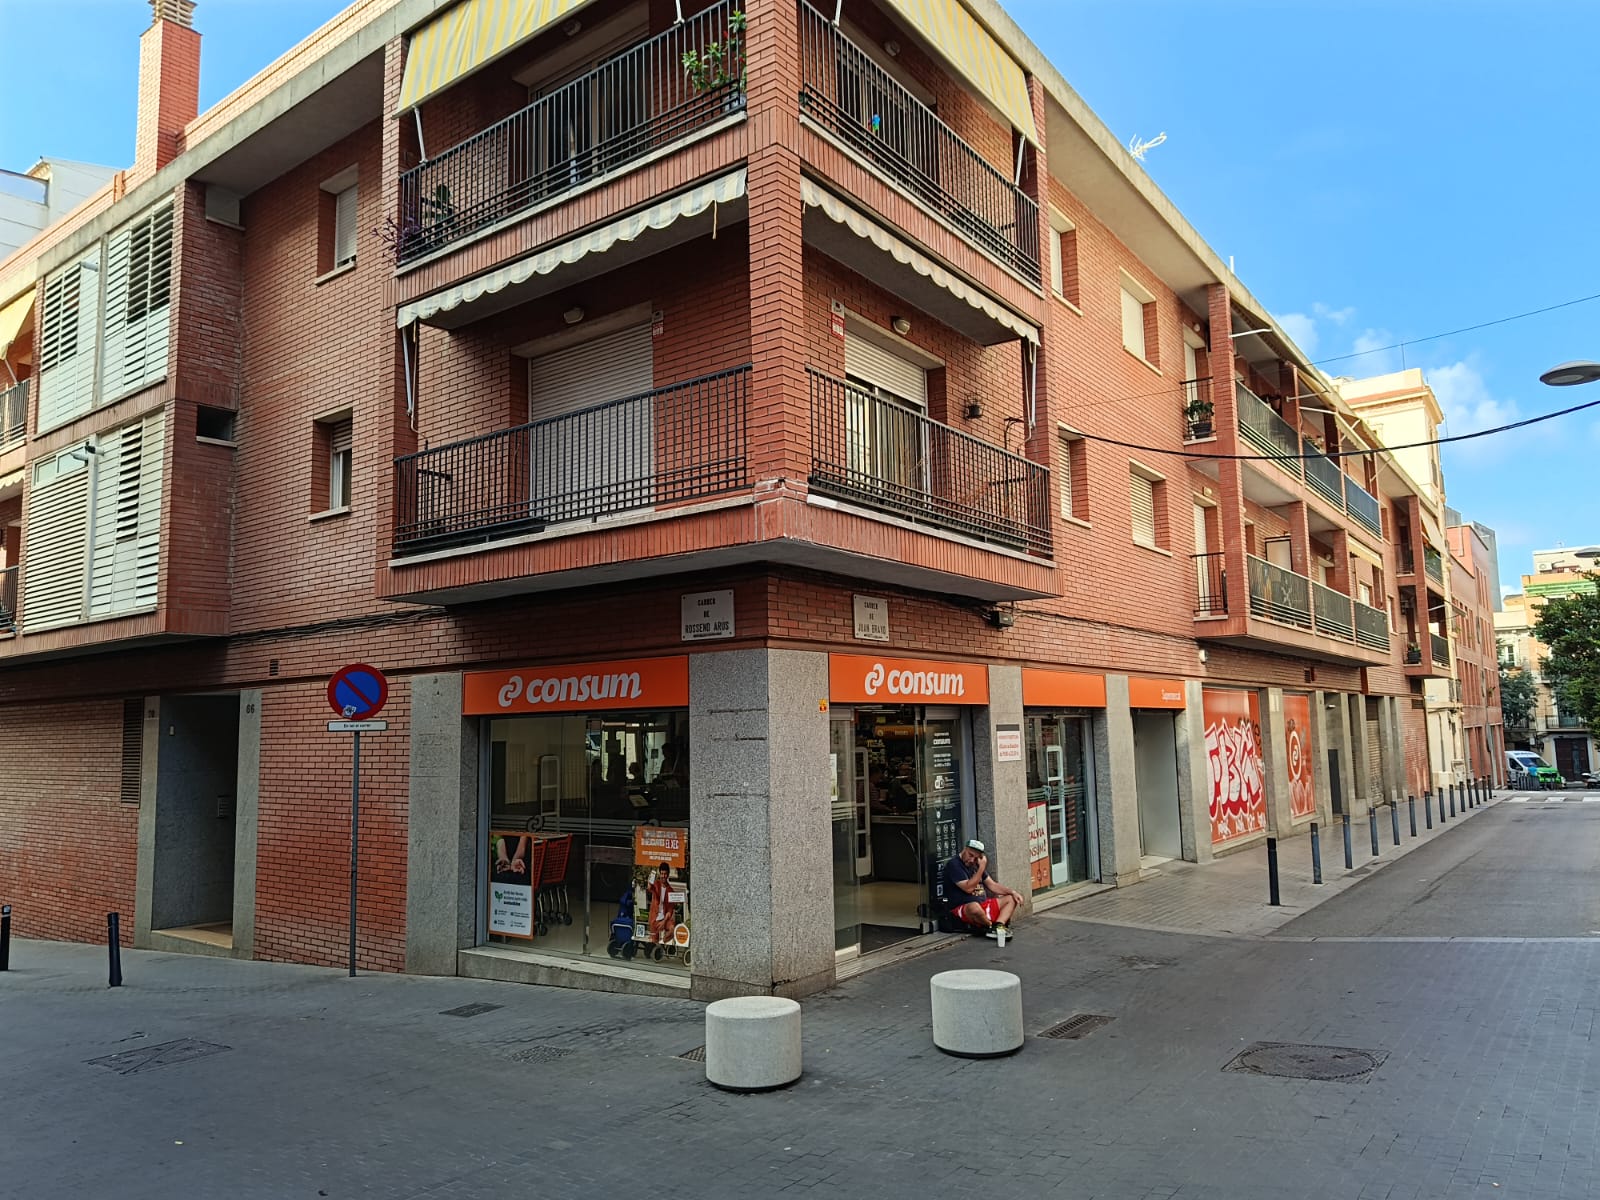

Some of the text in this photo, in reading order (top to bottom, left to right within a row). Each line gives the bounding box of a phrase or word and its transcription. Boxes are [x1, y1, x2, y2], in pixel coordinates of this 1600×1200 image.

[697, 598, 716, 606] CARRER
[703, 610, 710, 618] DE
[685, 622, 711, 634] ROSSEND
[526, 672, 642, 704] consum
[887, 669, 965, 697] consum
[246, 704, 255, 714] 66
